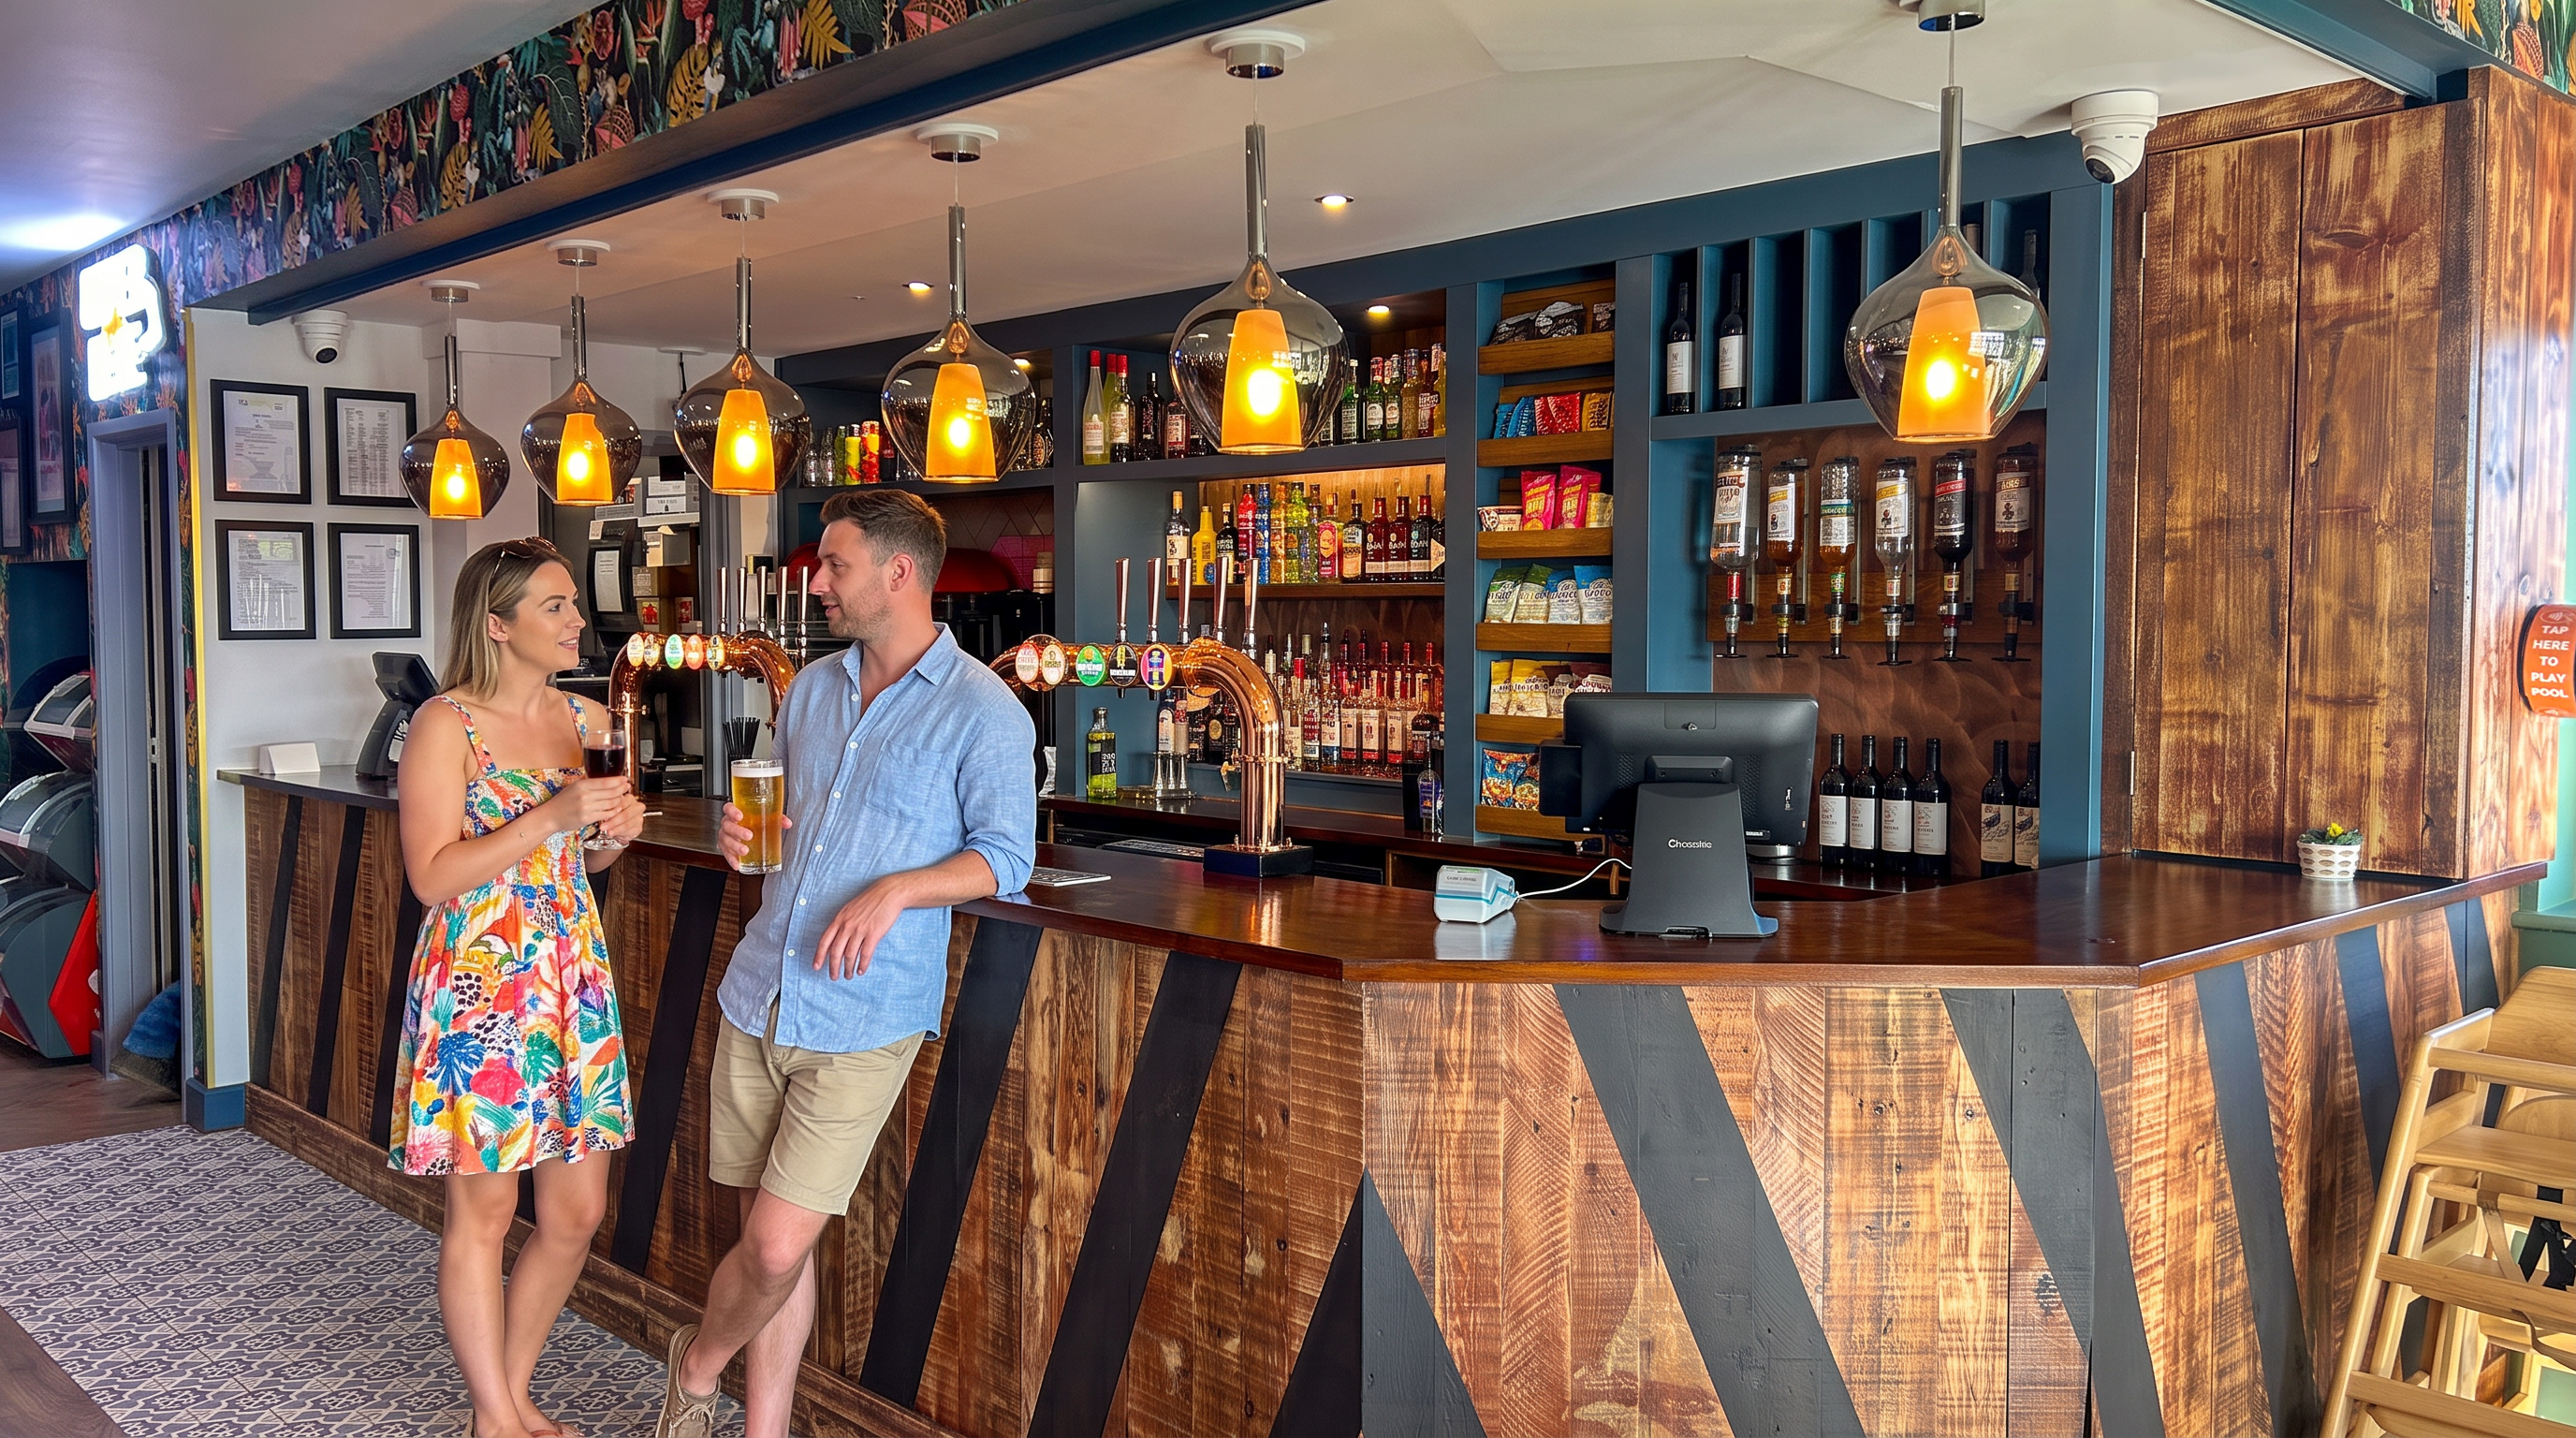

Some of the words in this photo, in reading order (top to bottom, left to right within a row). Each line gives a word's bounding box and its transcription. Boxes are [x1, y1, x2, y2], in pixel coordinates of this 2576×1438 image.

[2541, 625, 2569, 635] TAP
[2532, 639, 2570, 651] HERE
[2539, 656, 2558, 667] TO
[2531, 672, 2566, 683] PLAY
[2531, 688, 2569, 698] POOL
